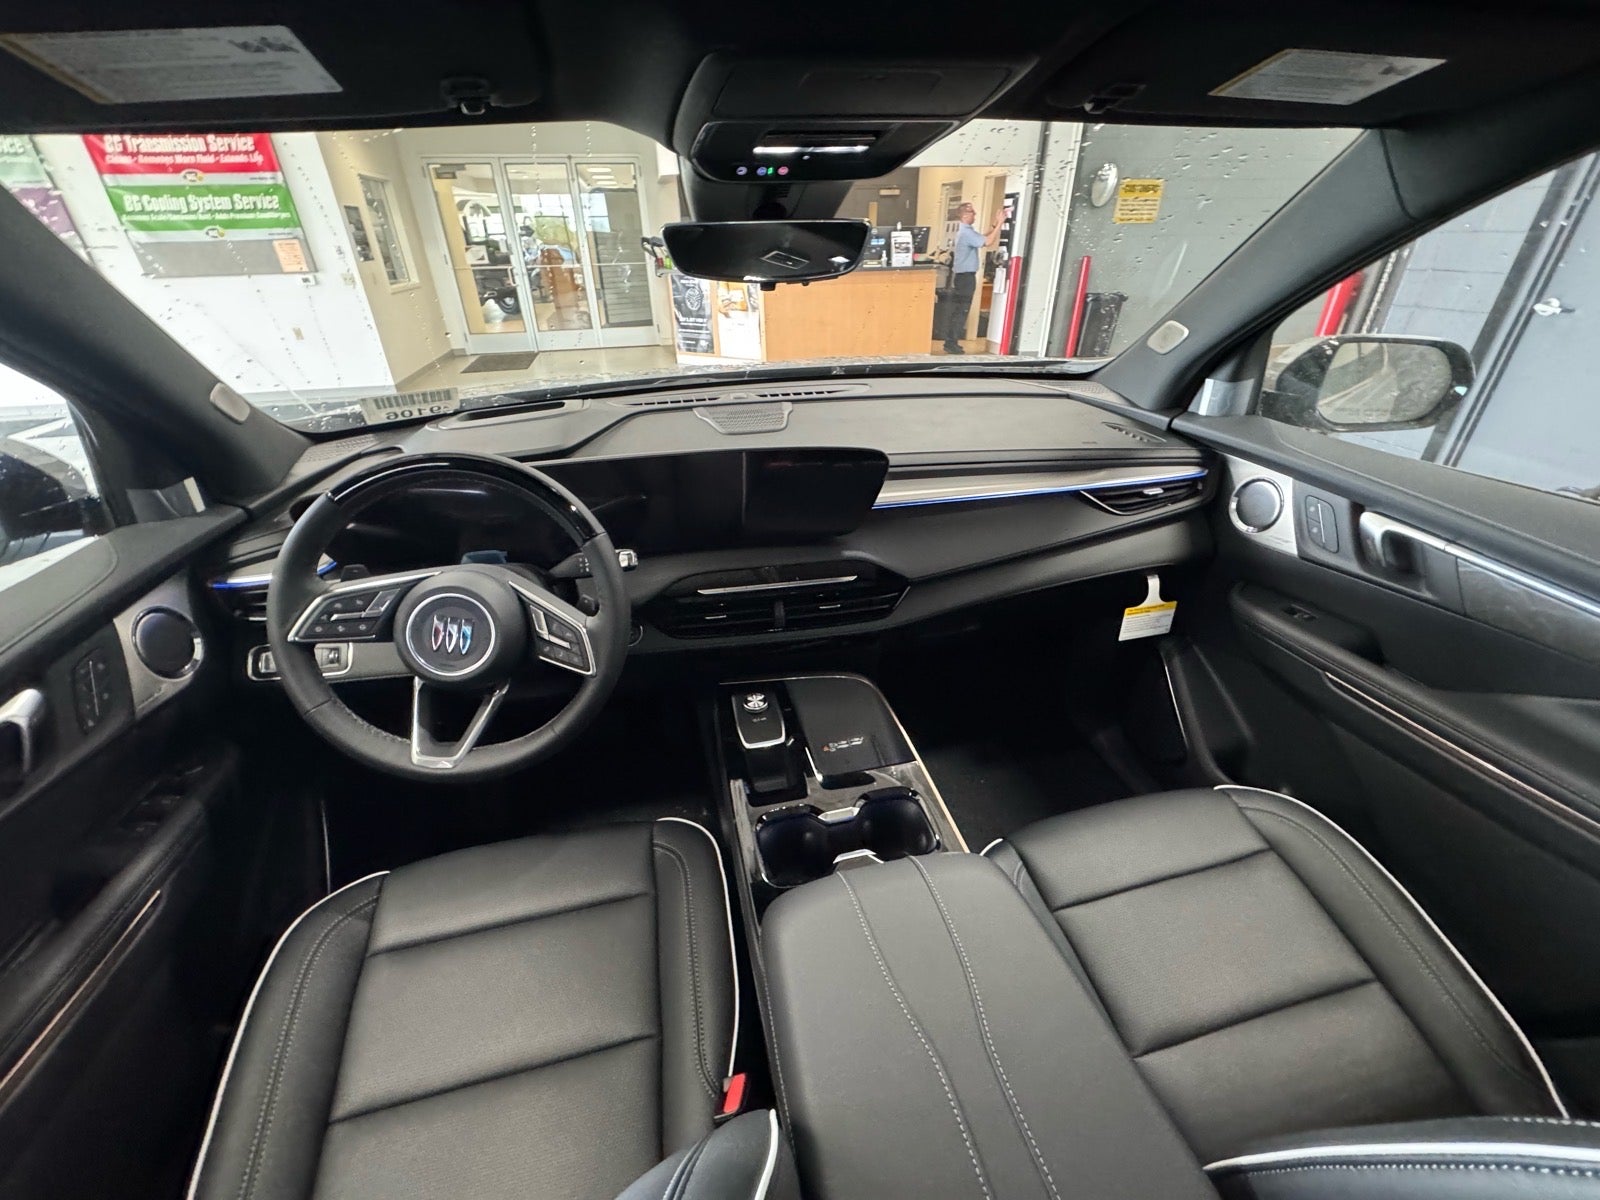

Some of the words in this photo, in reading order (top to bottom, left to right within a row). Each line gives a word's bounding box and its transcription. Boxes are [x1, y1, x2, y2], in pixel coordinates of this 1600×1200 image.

[125, 134, 206, 153] Transmission
[207, 133, 255, 153] Service
[142, 194, 188, 214] Cooling
[188, 194, 232, 213] System
[233, 193, 280, 211] Service
